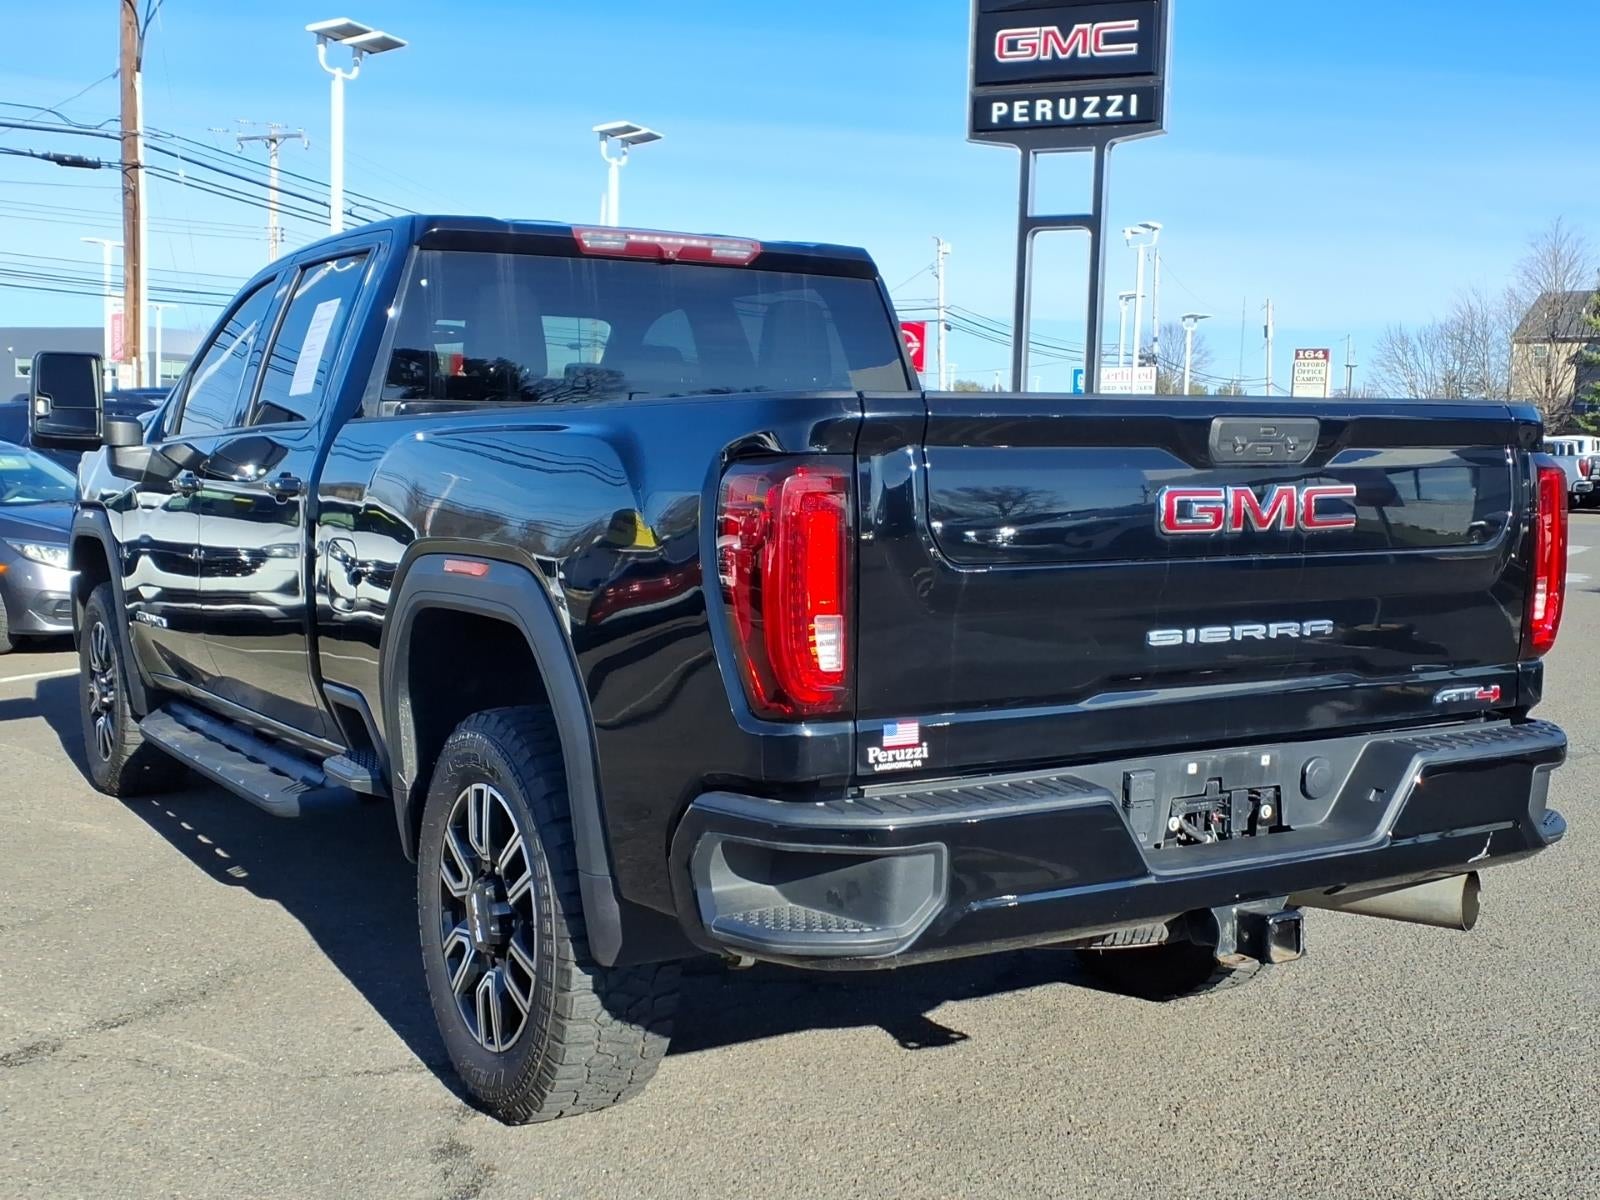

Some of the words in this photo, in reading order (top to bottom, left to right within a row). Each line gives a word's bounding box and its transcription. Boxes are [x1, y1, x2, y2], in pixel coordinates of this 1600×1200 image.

[995, 19, 1139, 62] GMC
[991, 94, 1138, 124] PERUZZI
[1297, 350, 1325, 359] 164
[1157, 484, 1357, 536] GMC
[1147, 619, 1334, 646] SIERRA
[1433, 685, 1501, 704] AT4
[867, 742, 929, 764] Peruzzi
